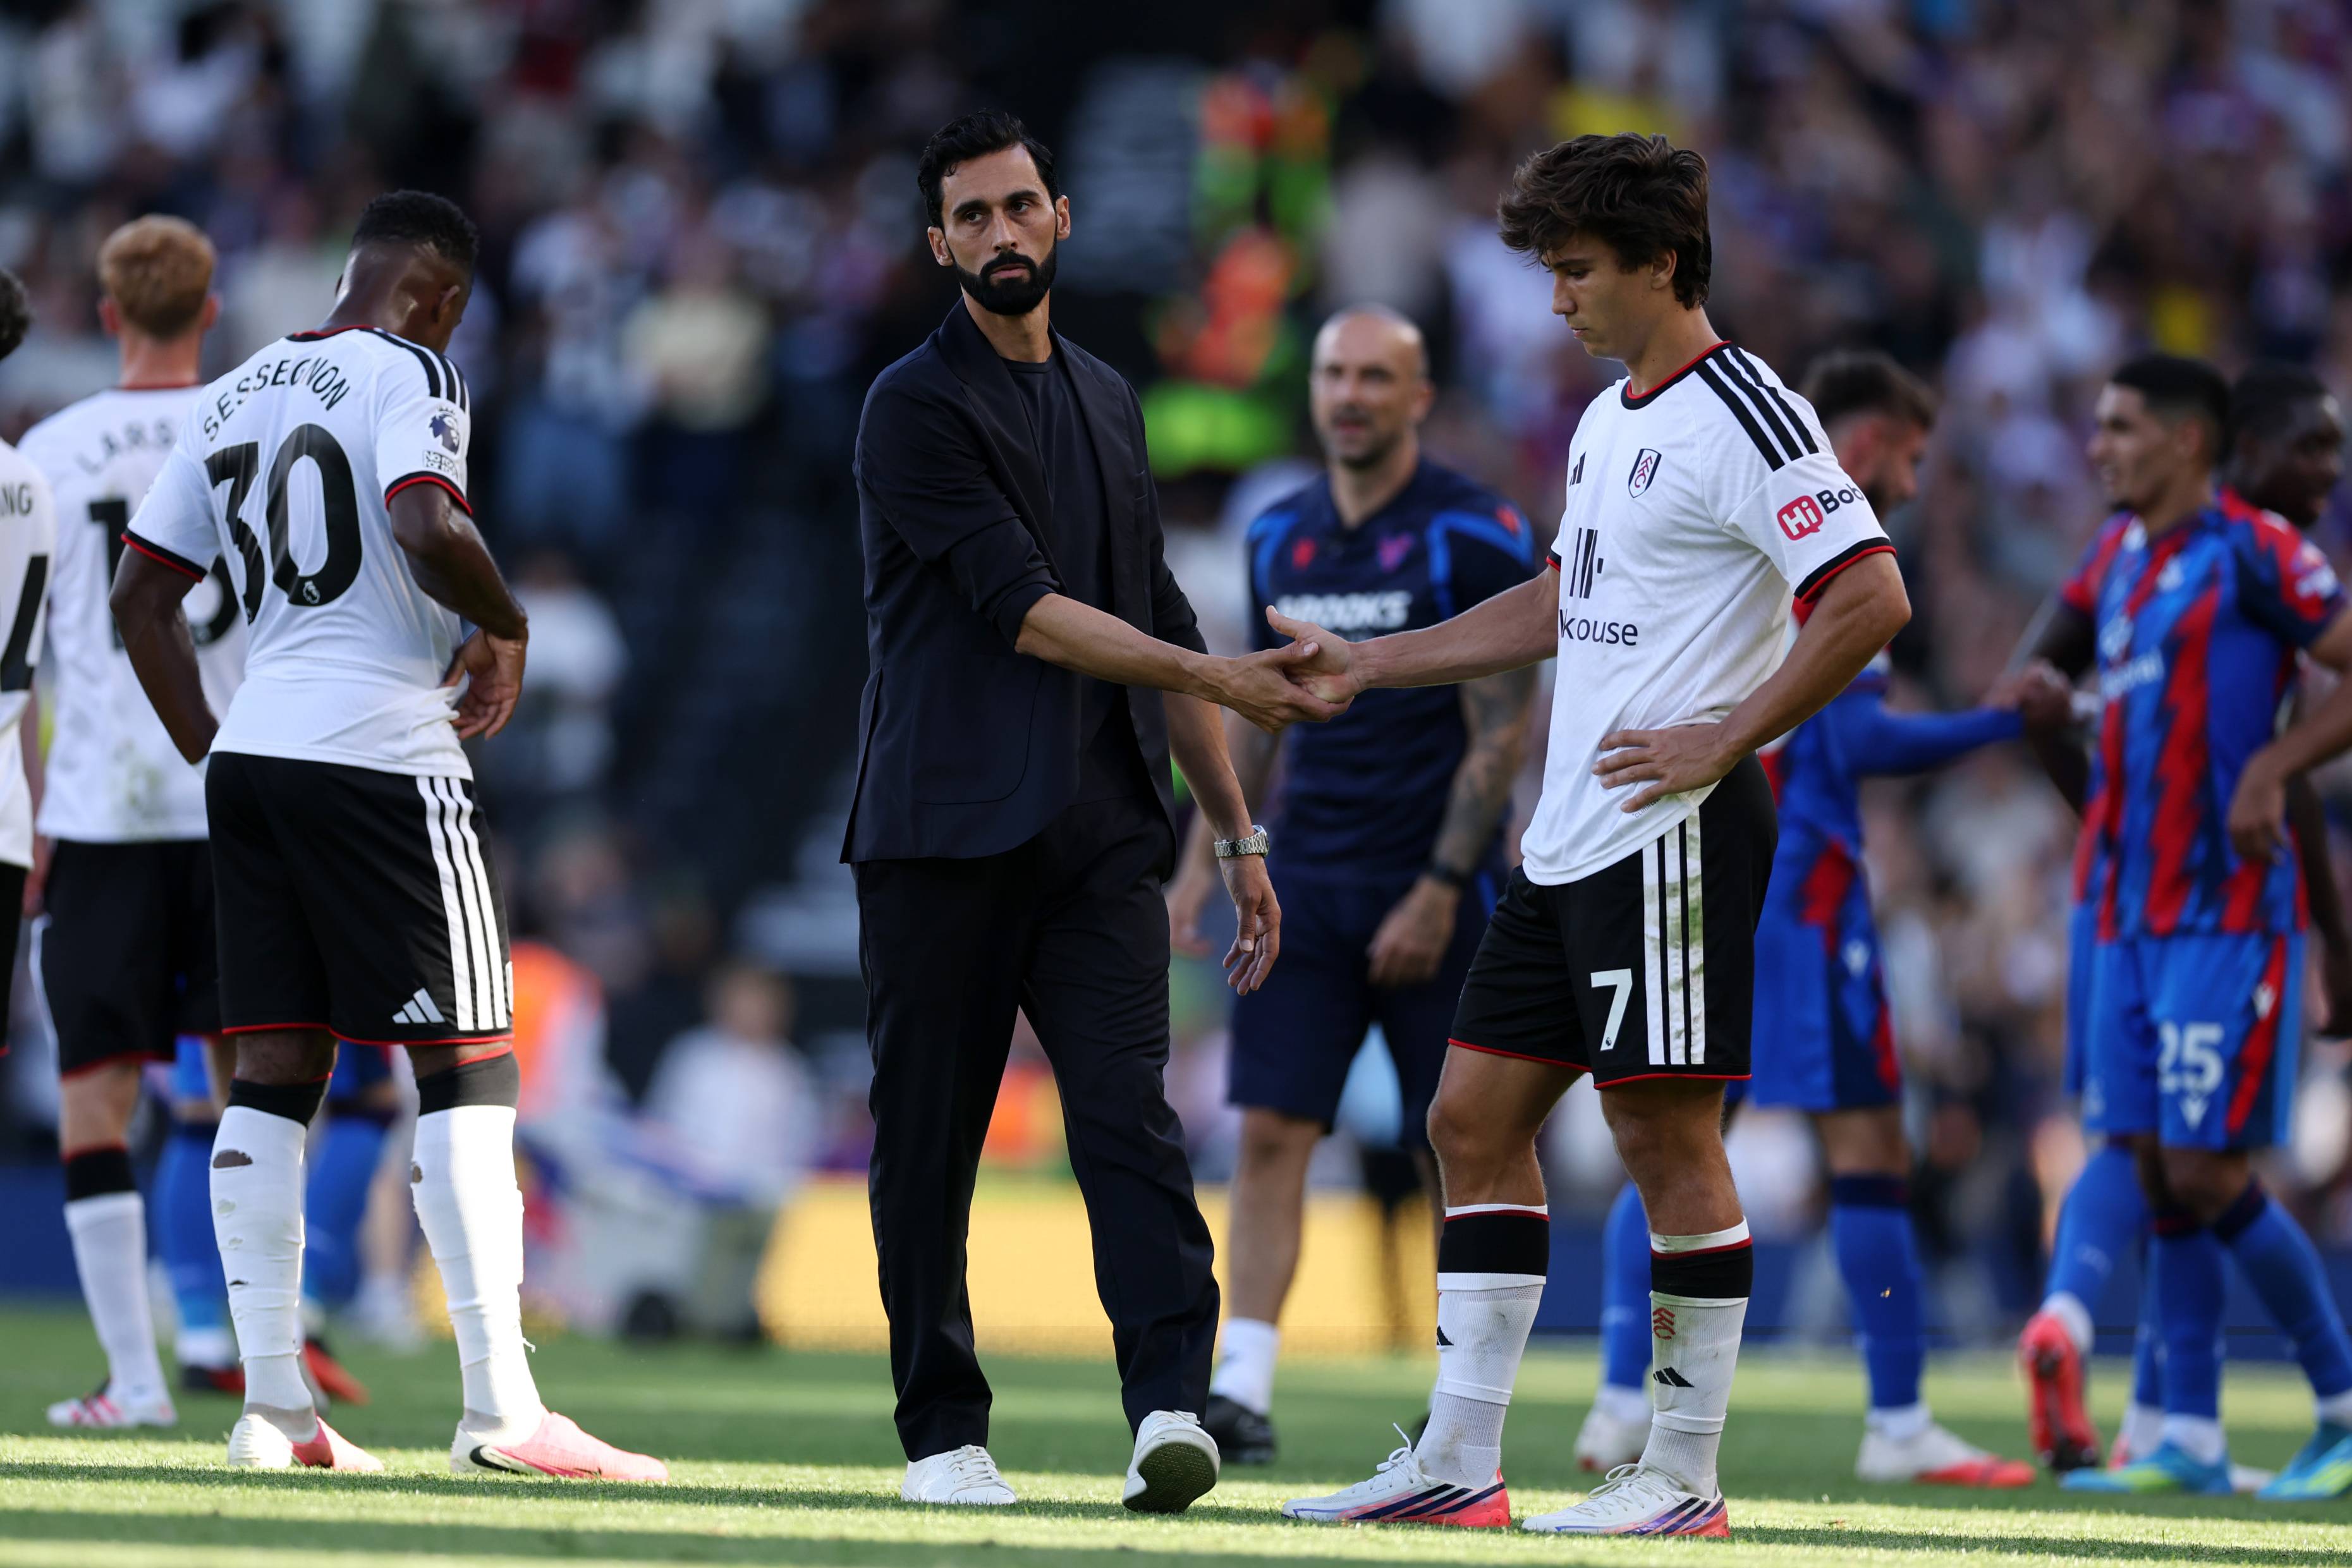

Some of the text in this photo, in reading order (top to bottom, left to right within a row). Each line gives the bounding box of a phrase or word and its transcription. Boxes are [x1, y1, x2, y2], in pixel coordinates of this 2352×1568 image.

[204, 422, 363, 626] 30
[1590, 968, 1633, 1052] 7
[2157, 1019, 2224, 1095] 25
